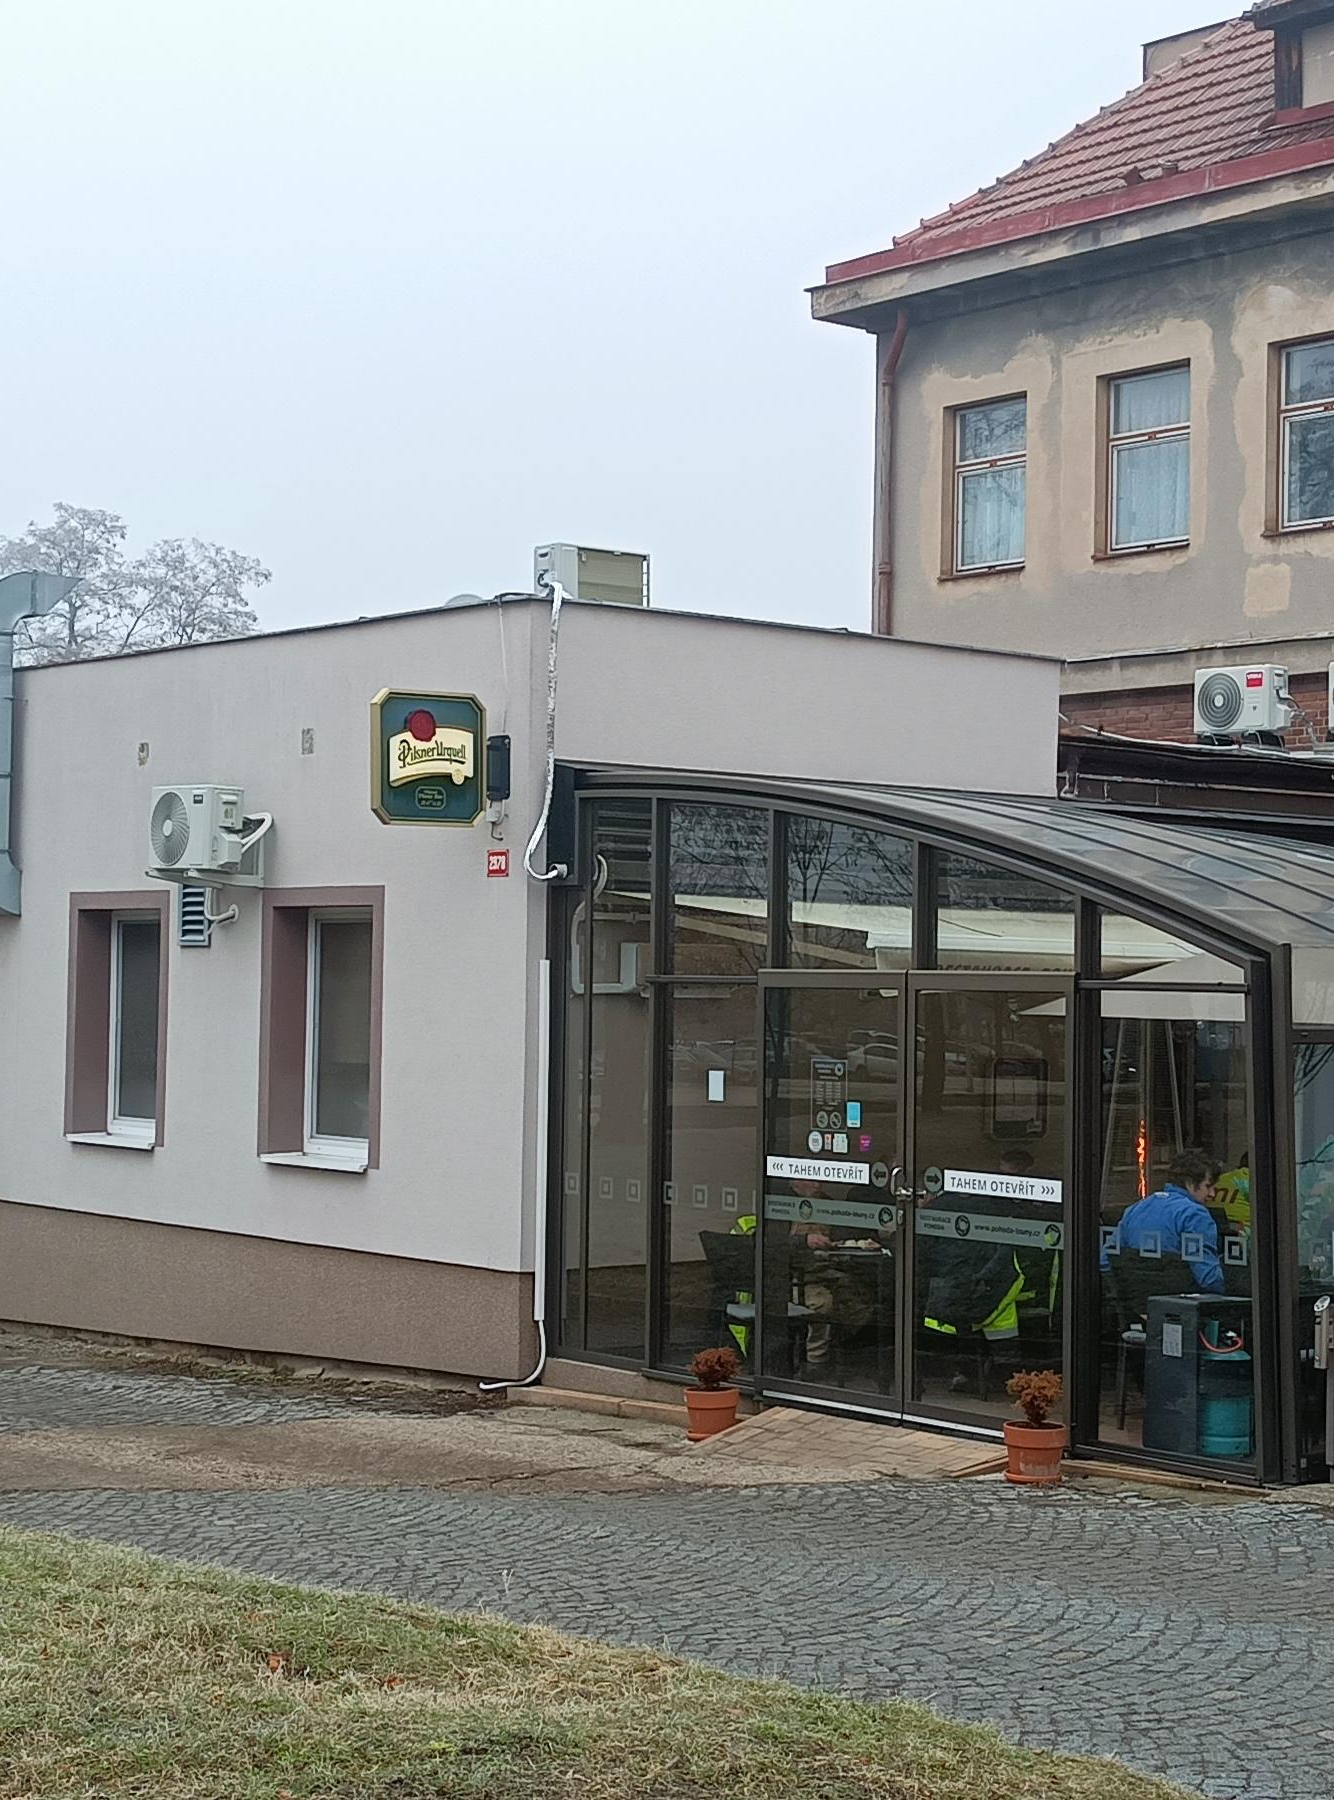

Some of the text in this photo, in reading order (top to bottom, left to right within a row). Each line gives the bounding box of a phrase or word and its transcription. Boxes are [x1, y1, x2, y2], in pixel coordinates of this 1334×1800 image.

[398, 739, 466, 768] Pilsner Urquell
[788, 1163, 864, 1181] TAHEM OTEVŘÍT
[950, 1176, 1036, 1196] TAHEM OTEVŘÍT
